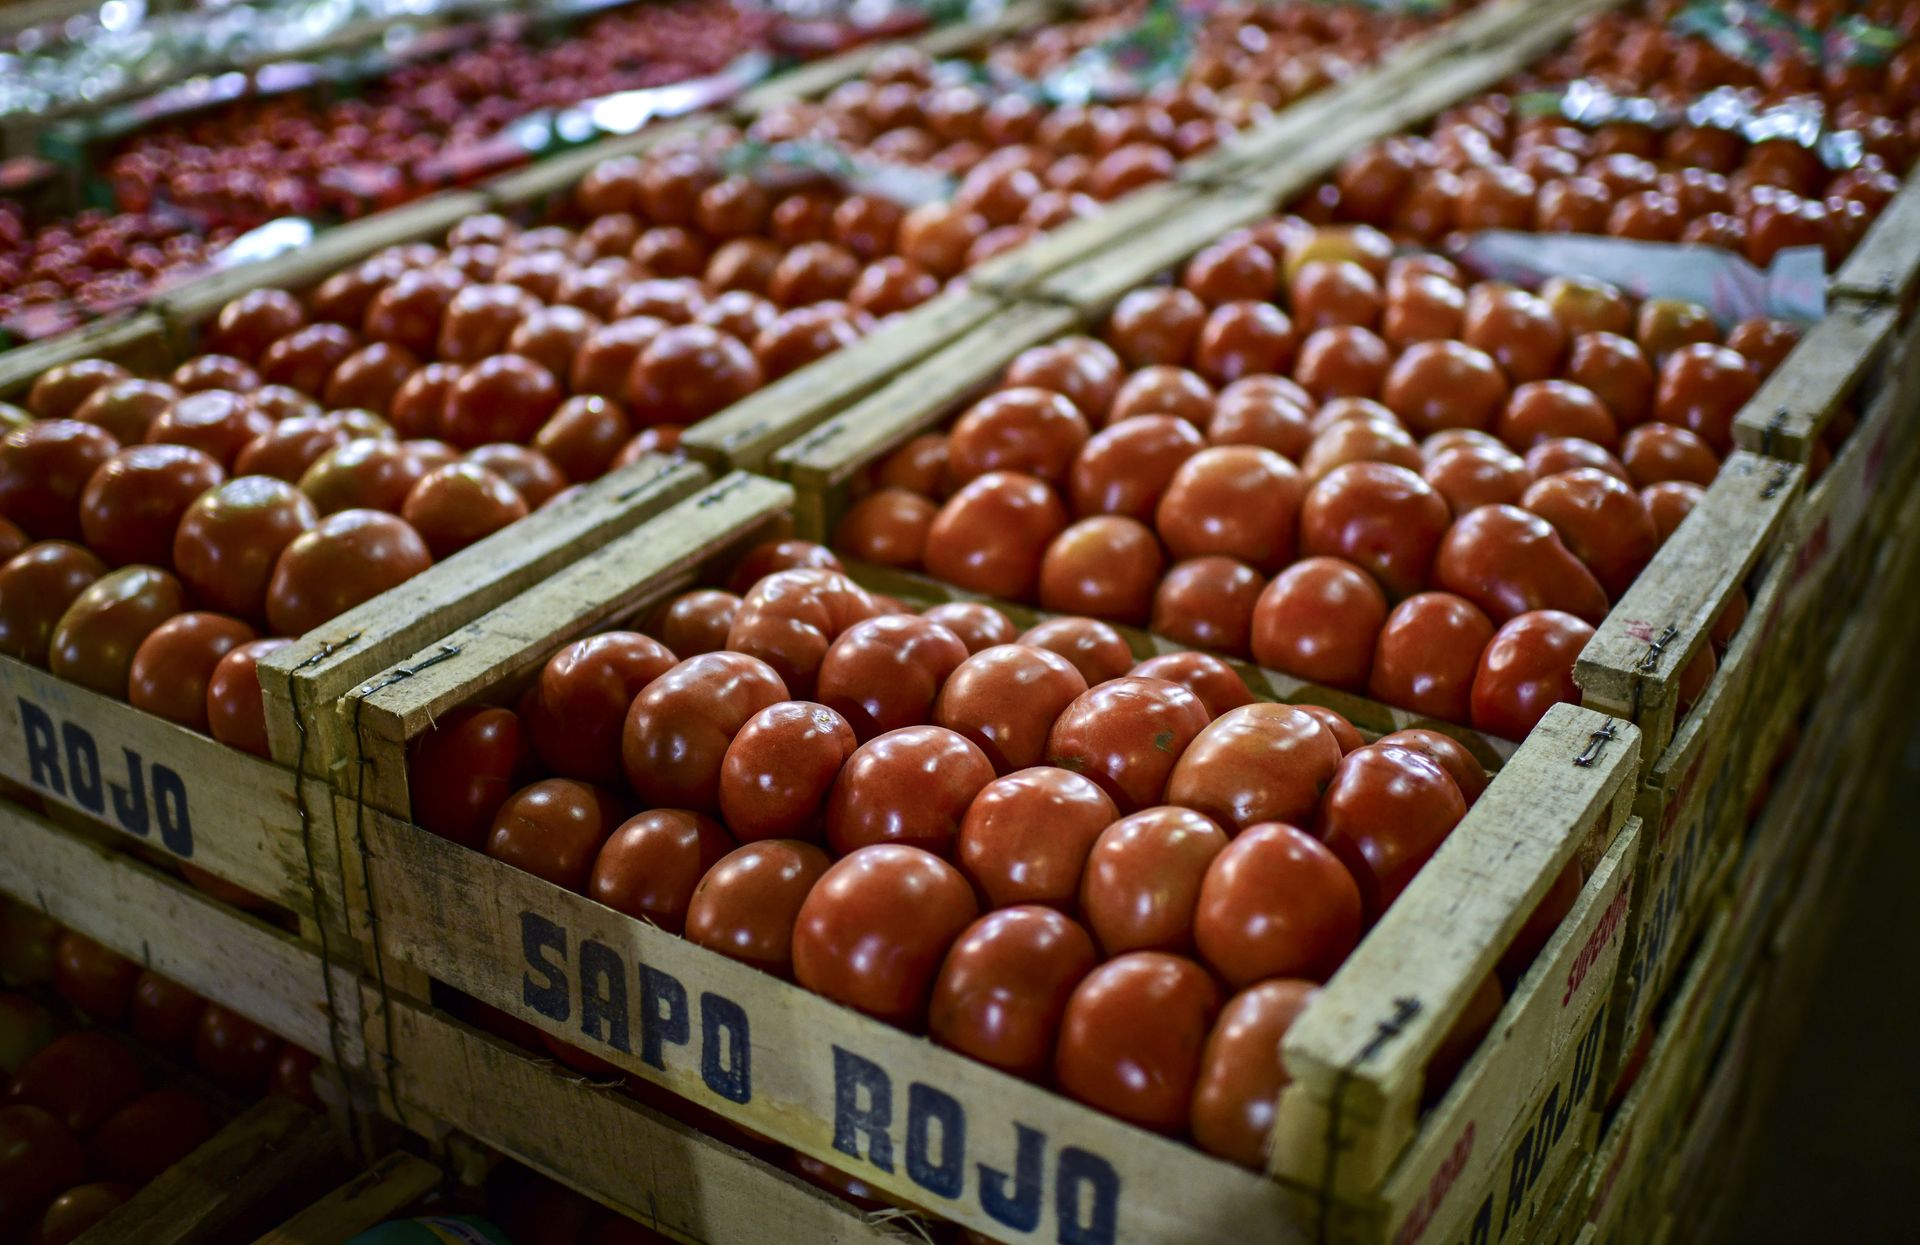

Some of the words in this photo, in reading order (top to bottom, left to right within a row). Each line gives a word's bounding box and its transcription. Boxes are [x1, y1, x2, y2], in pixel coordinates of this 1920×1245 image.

[17, 696, 193, 859] ROJO
[521, 911, 752, 1105] SAPO
[831, 1044, 1120, 1245] ROJO
